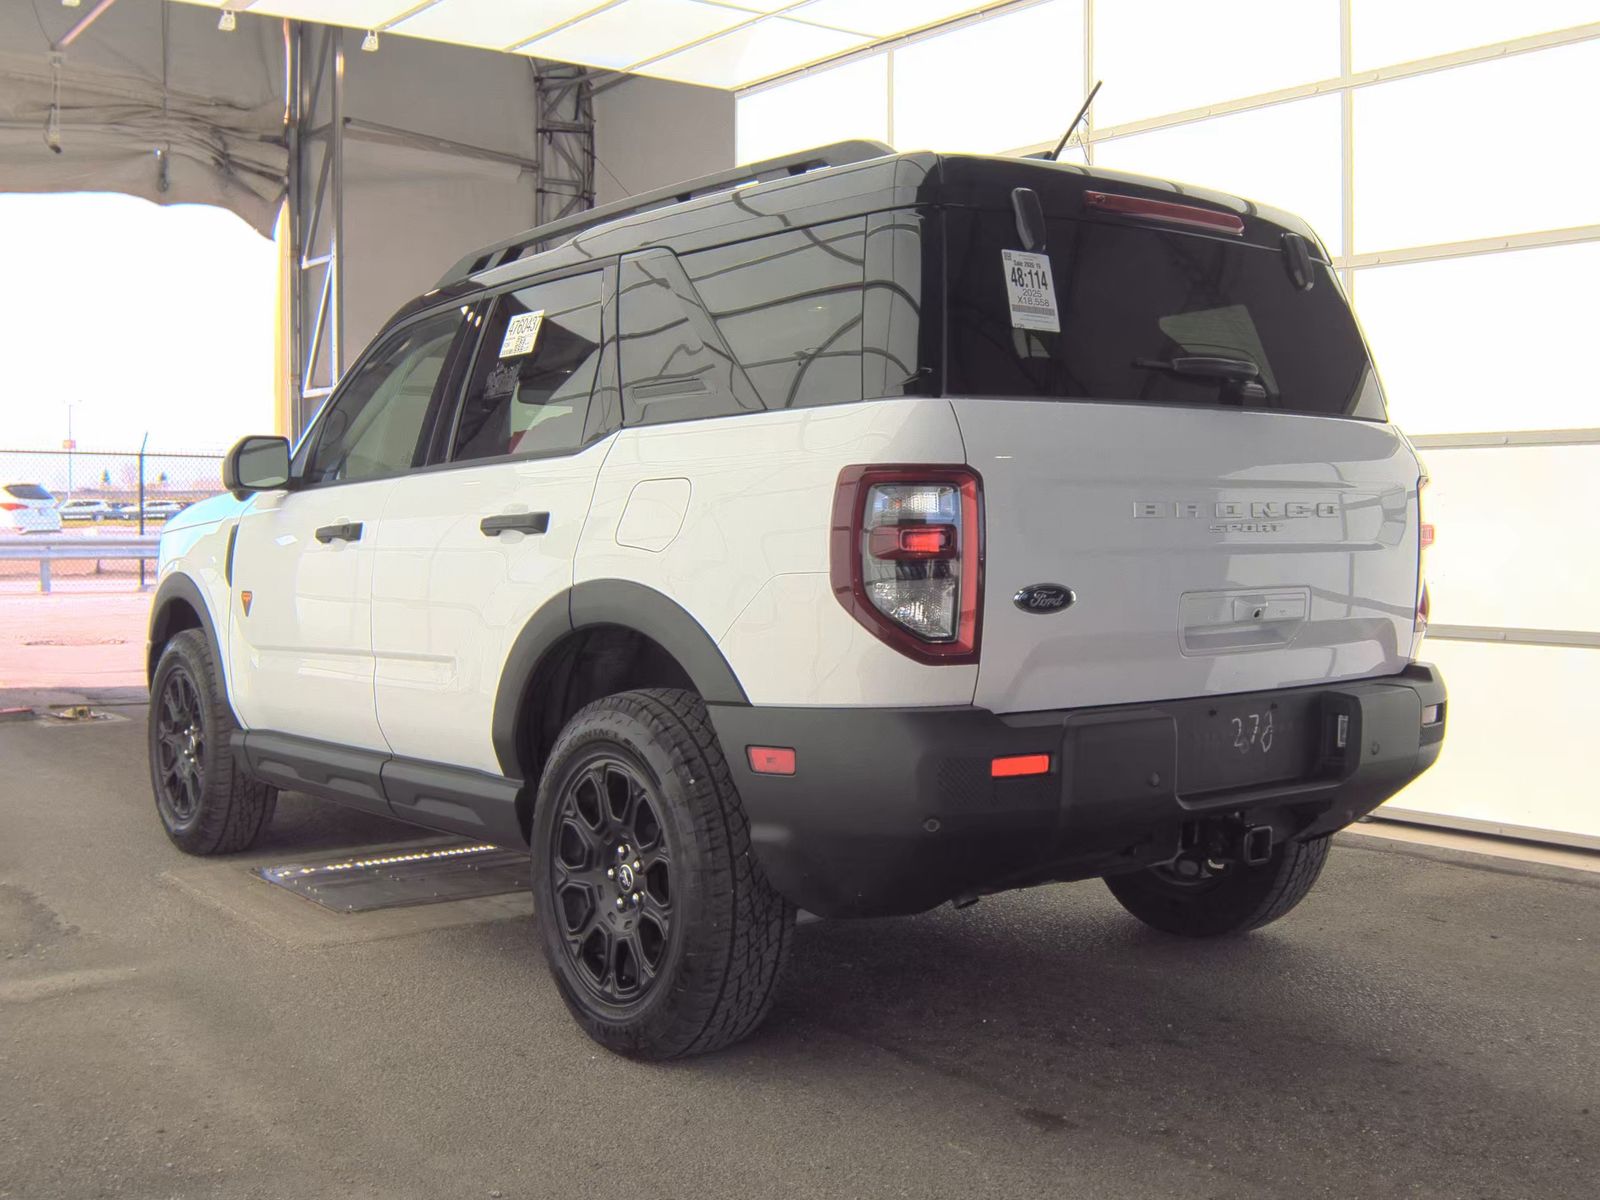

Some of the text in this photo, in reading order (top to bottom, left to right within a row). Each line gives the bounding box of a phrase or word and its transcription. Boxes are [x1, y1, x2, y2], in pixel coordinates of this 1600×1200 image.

[1011, 267, 1048, 290] 48:114
[1022, 289, 1042, 297] 2025
[1133, 501, 1340, 518] BRONCO
[1209, 523, 1283, 534] SPORT
[1030, 590, 1065, 607] Ford
